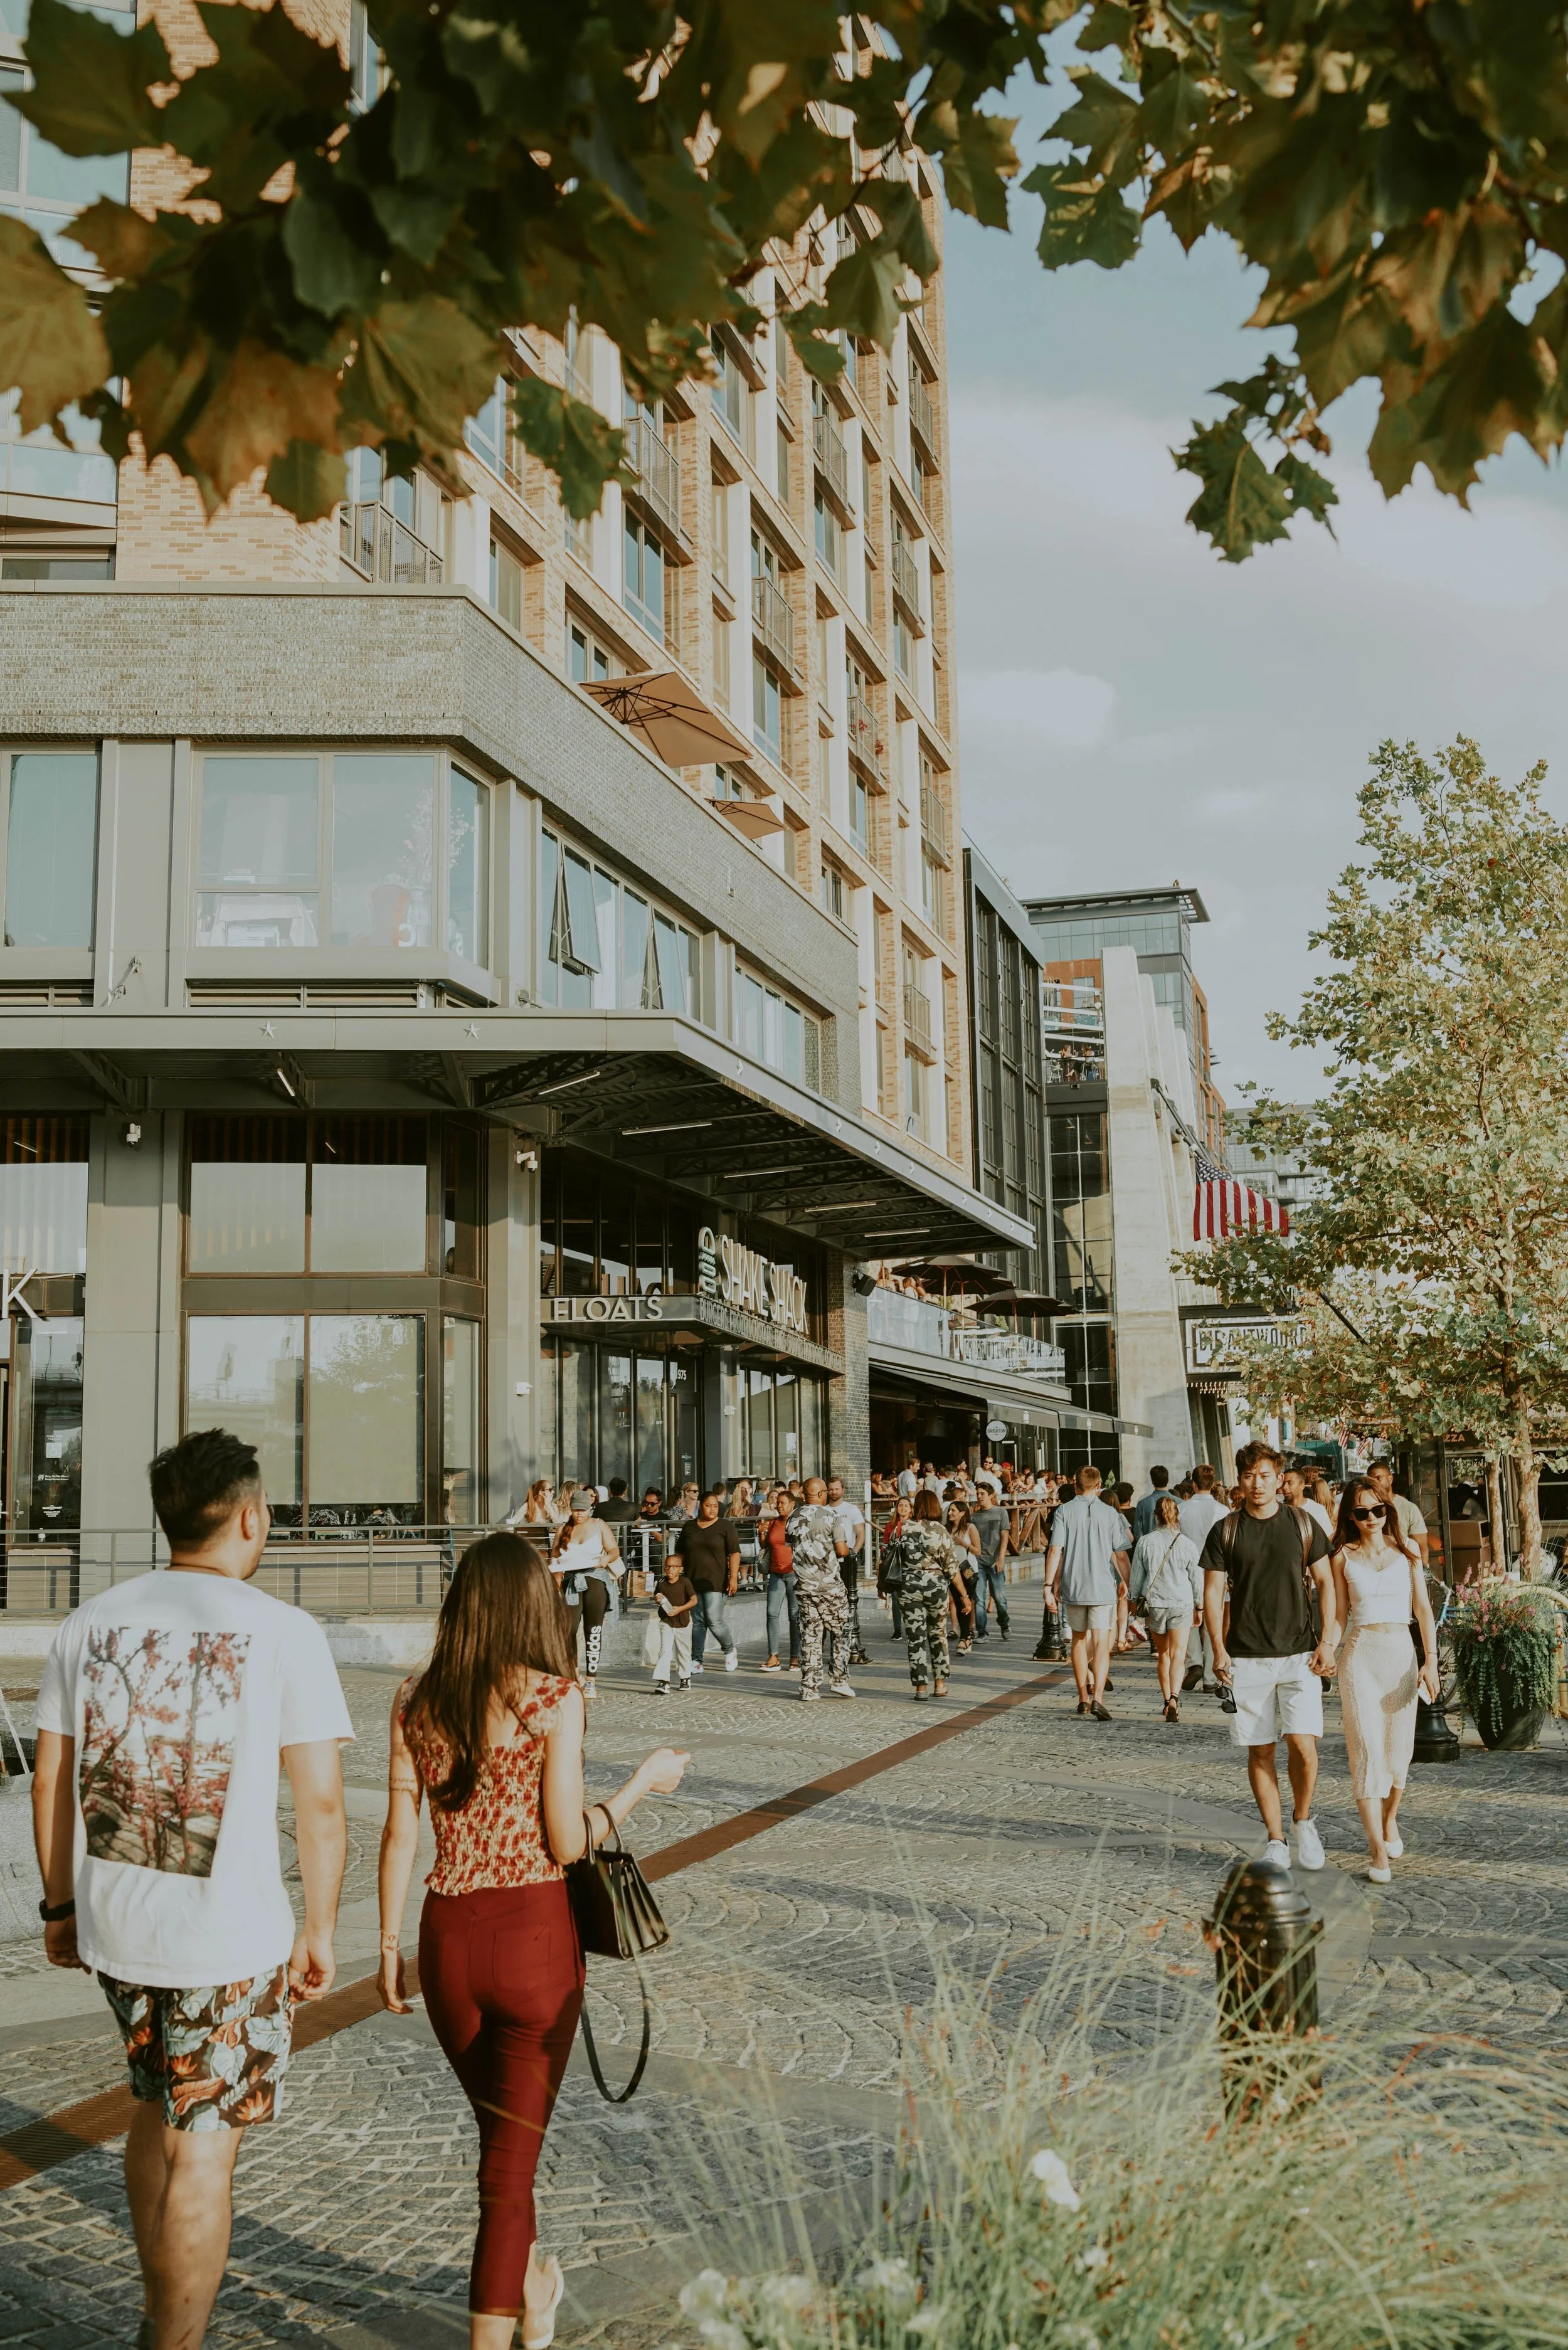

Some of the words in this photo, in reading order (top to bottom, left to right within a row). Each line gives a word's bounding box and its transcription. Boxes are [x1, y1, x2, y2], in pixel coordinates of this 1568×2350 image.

[716, 1234, 769, 1317] SHAKE
[764, 1262, 808, 1335] SHACK
[554, 1296, 663, 1321] FLOATS
[699, 1297, 728, 1331] BURGERS
[677, 1369, 687, 1380] 975
[1444, 1434, 1465, 1442] ZZA
[586, 1625, 601, 1673] adidas
